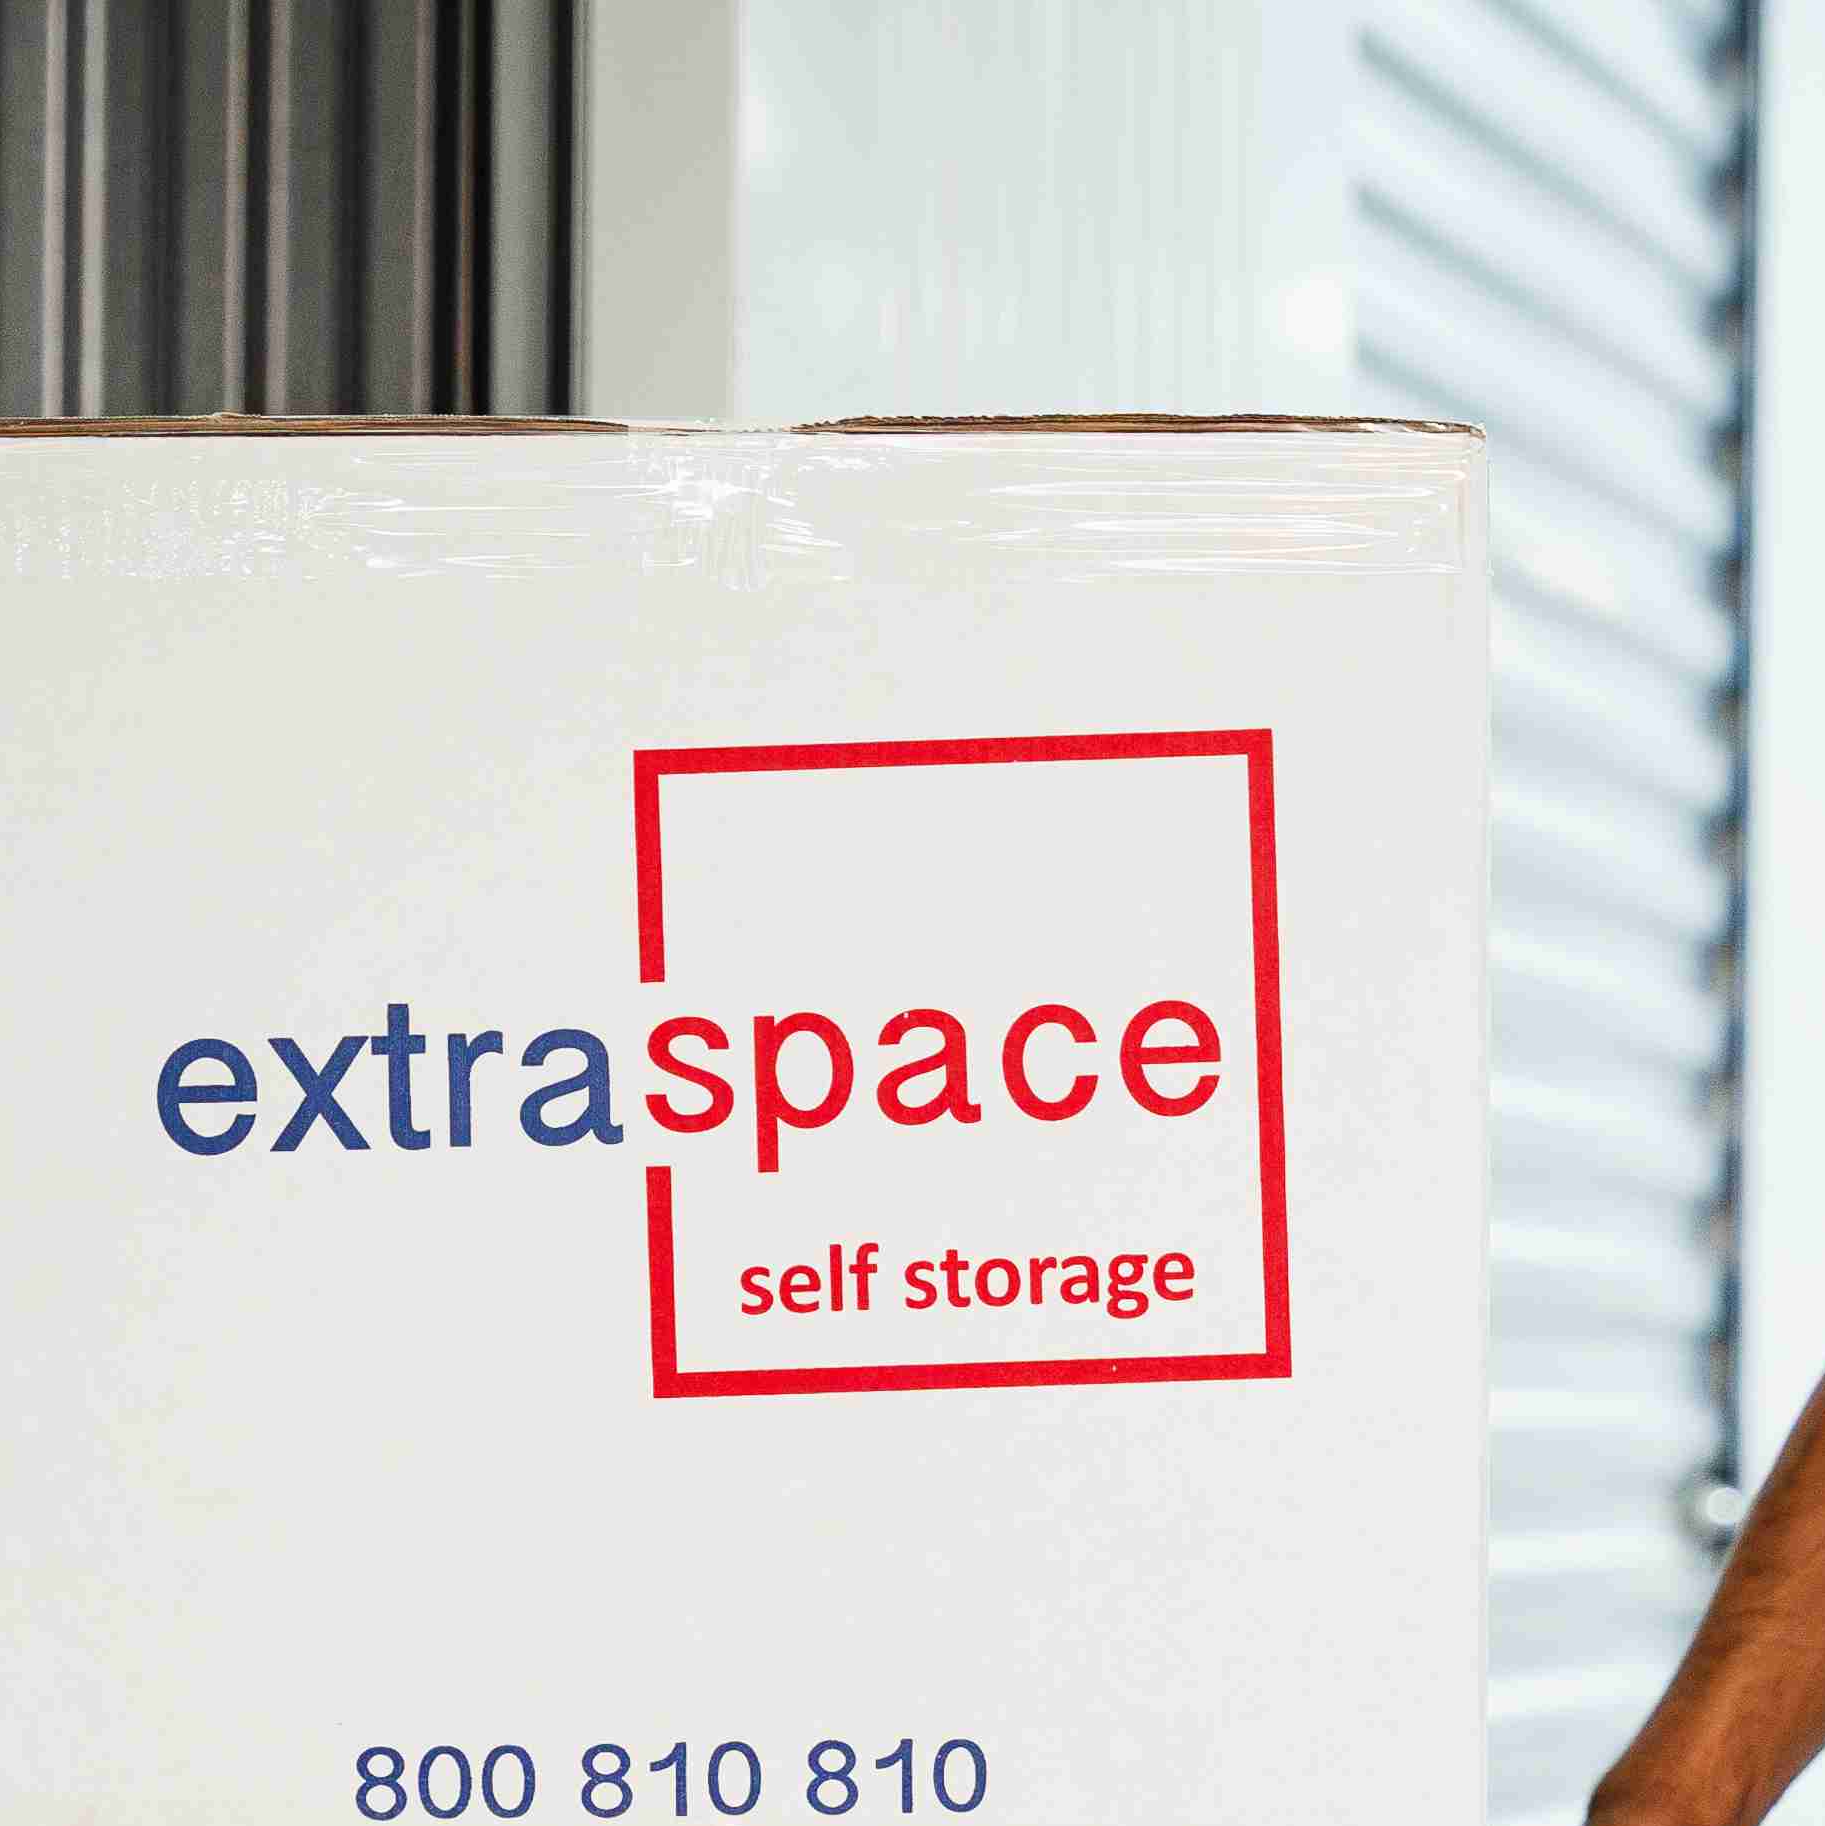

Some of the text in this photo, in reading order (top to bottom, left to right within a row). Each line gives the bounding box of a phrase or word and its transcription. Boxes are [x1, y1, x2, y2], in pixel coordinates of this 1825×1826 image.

[740, 1242, 1195, 1319] self storage
[355, 1738, 987, 1821] 800 810 810
